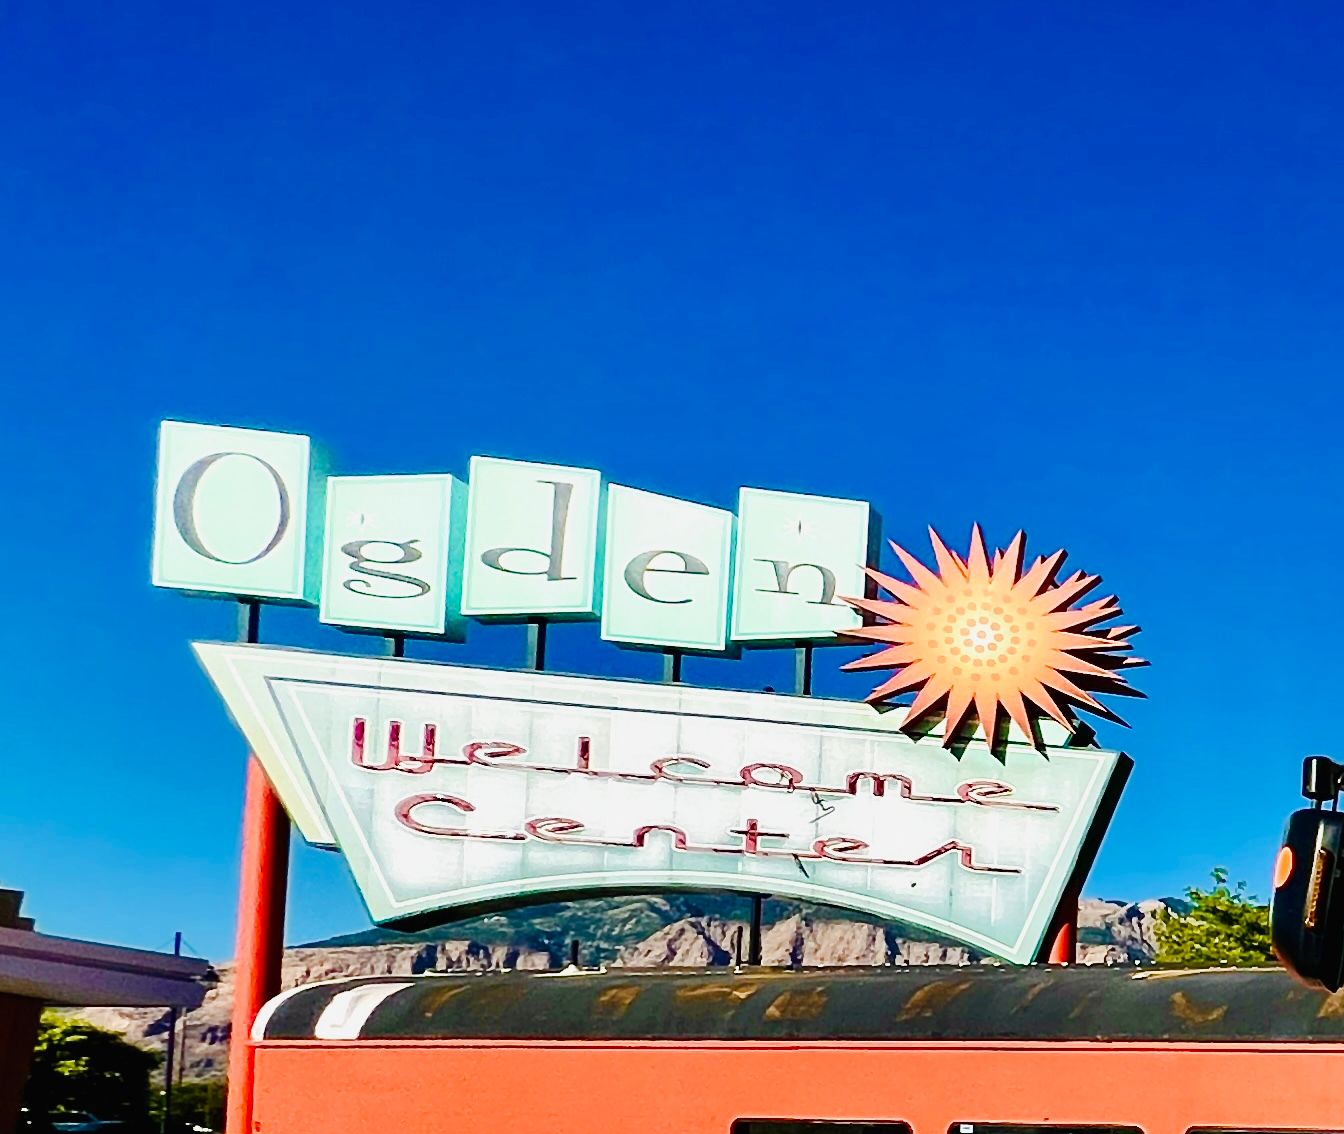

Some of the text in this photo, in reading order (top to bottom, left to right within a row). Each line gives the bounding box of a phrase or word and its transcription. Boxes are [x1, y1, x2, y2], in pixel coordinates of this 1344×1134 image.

[173, 452, 846, 606] Ogden
[351, 717, 1060, 811] Welcome
[395, 794, 1021, 873] Center
